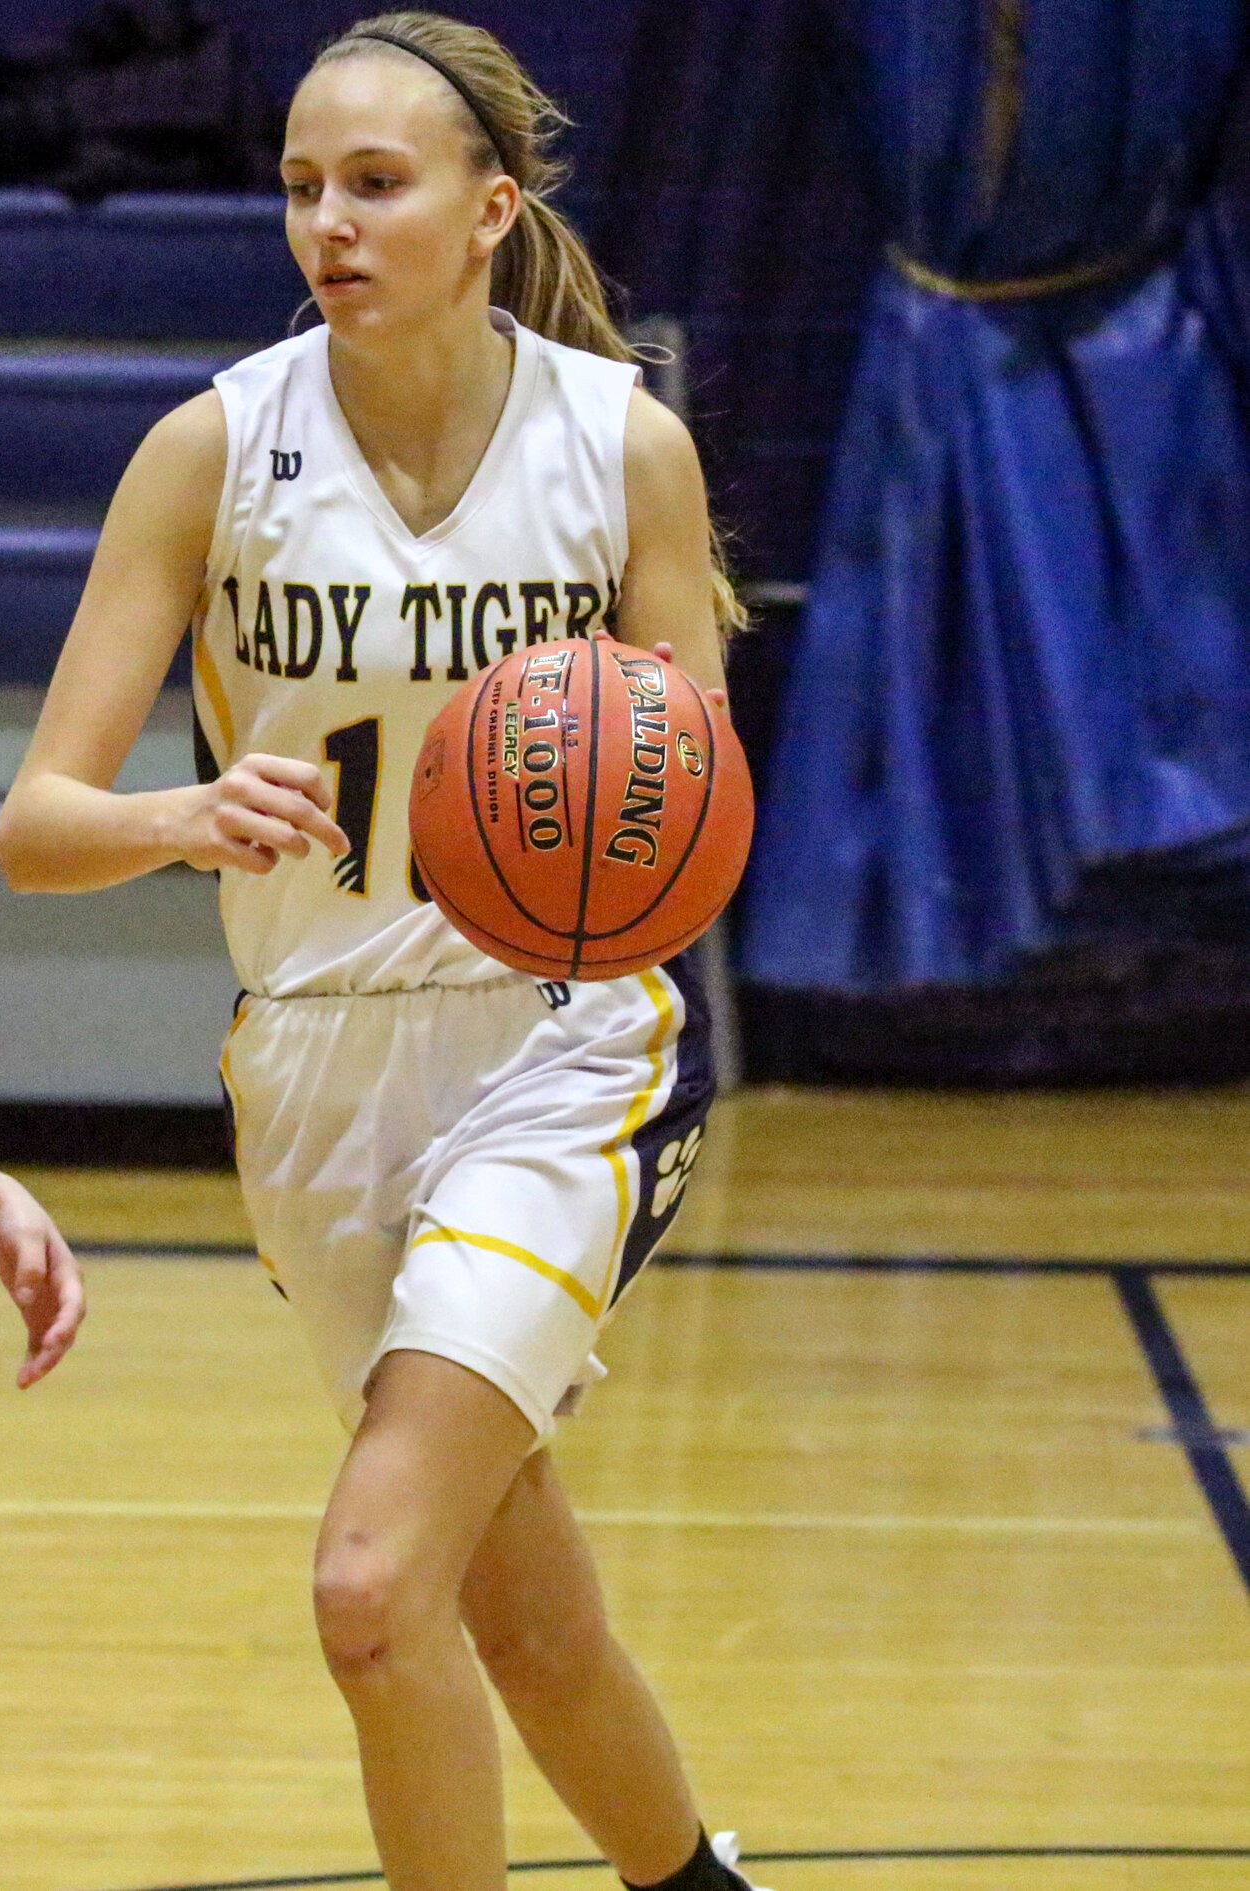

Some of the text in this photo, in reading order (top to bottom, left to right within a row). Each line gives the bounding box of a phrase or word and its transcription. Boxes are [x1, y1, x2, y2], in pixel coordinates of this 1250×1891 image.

[222, 575, 371, 683] LADY
[487, 709, 499, 766] CHANNEL
[502, 700, 520, 780] LEGACY
[603, 652, 668, 869] SPALDING
[322, 715, 435, 903] 1
[487, 772, 499, 823] DESIGN
